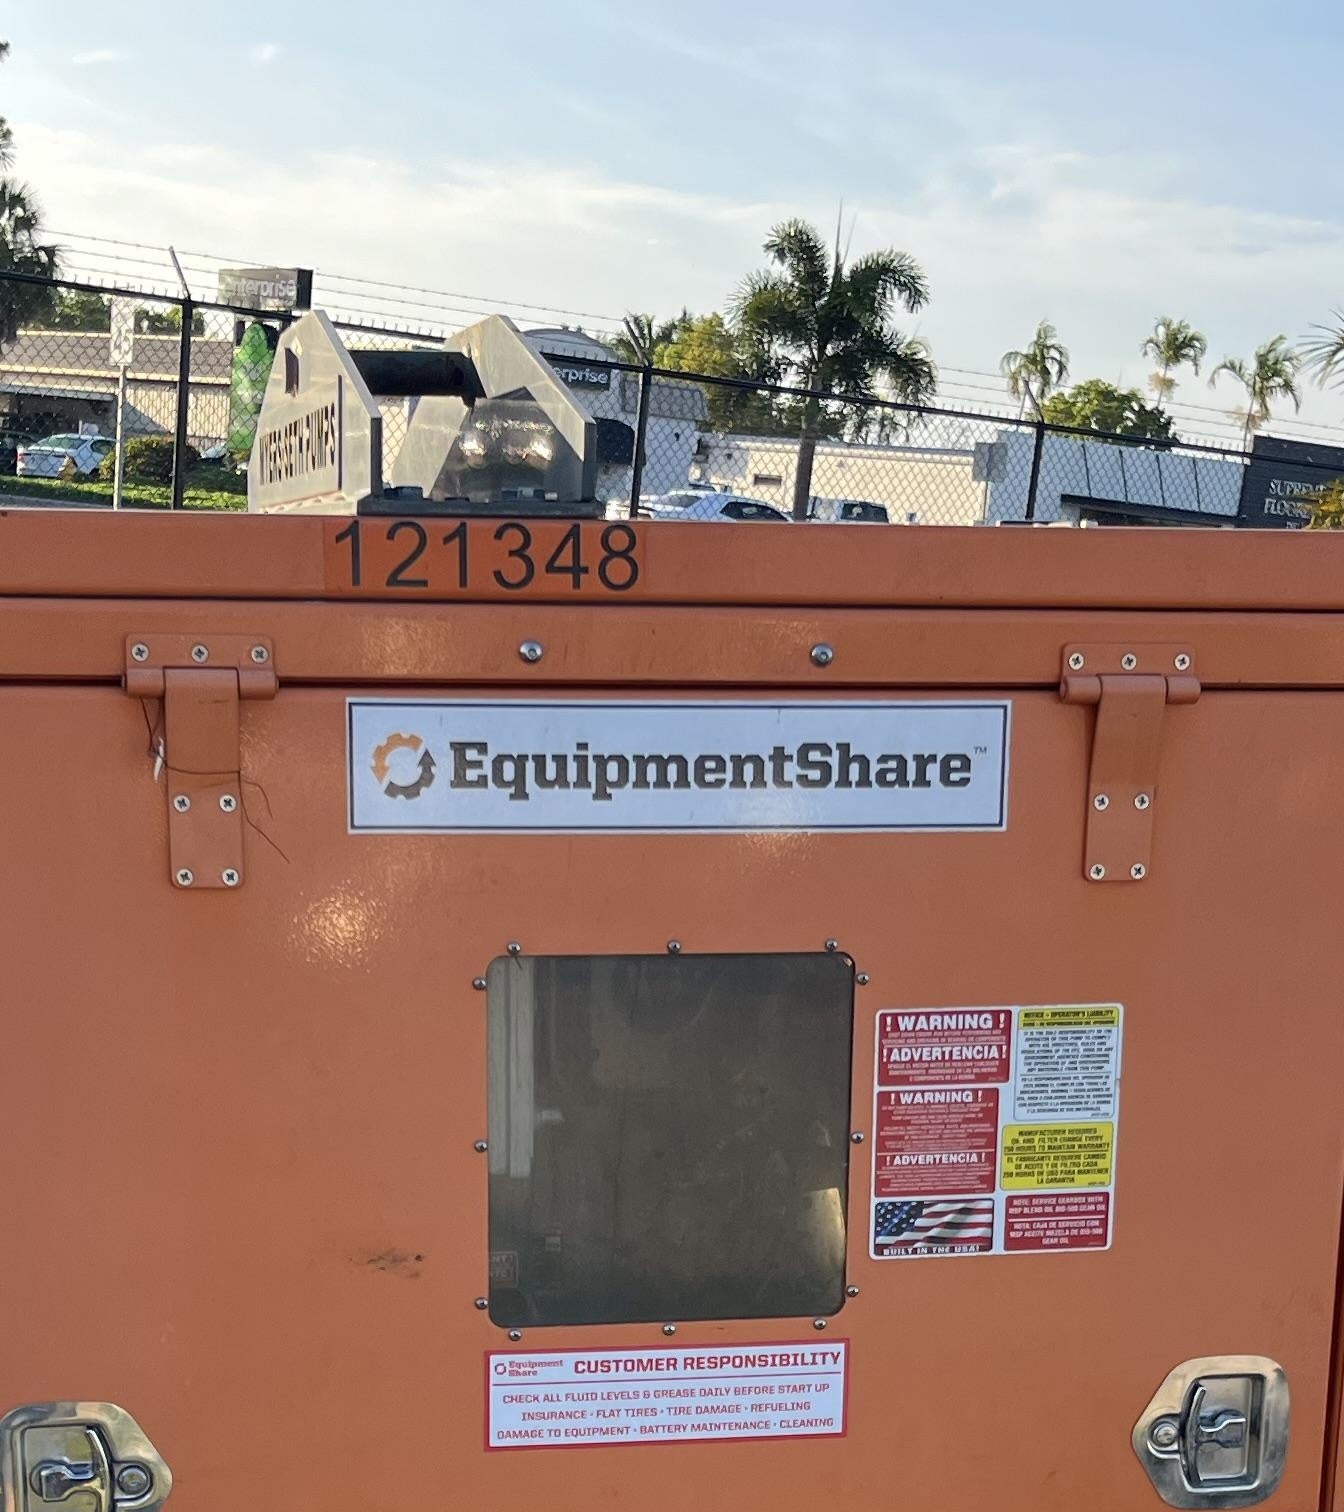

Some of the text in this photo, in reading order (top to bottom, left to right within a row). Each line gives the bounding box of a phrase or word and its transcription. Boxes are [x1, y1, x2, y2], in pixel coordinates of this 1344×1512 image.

[306, 403, 335, 472] PUMPS
[335, 520, 639, 590] 121348
[898, 1014, 992, 1031] WARNING
[890, 1046, 999, 1062] ADVERTENCIA
[900, 1091, 973, 1104] WARNING
[894, 1153, 977, 1165] ADVERTENCIA
[508, 1360, 563, 1368] Equipment
[574, 1351, 841, 1374] CUSTOMER RESPONSIBILITY
[503, 1394, 540, 1404] CHECK
[543, 1393, 561, 1402] ALL
[565, 1392, 597, 1402] FLUID
[600, 1390, 639, 1400] LEVELS
[653, 1388, 695, 1399] GREASE
[699, 1386, 730, 1397] DAILY
[734, 1385, 774, 1395] BEFORE
[778, 1383, 812, 1394] START
[814, 1383, 830, 1393] UP
[521, 1410, 587, 1421] INSURANCE
[625, 1407, 657, 1417] TIRES
[667, 1406, 692, 1416] TIRE
[695, 1404, 741, 1415] DAMAGE
[750, 1401, 811, 1413] REFUELING
[497, 1418, 834, 1439] DAMAGE TO EQUIPMENT BATTERY MAINTENANCE CLEANING
